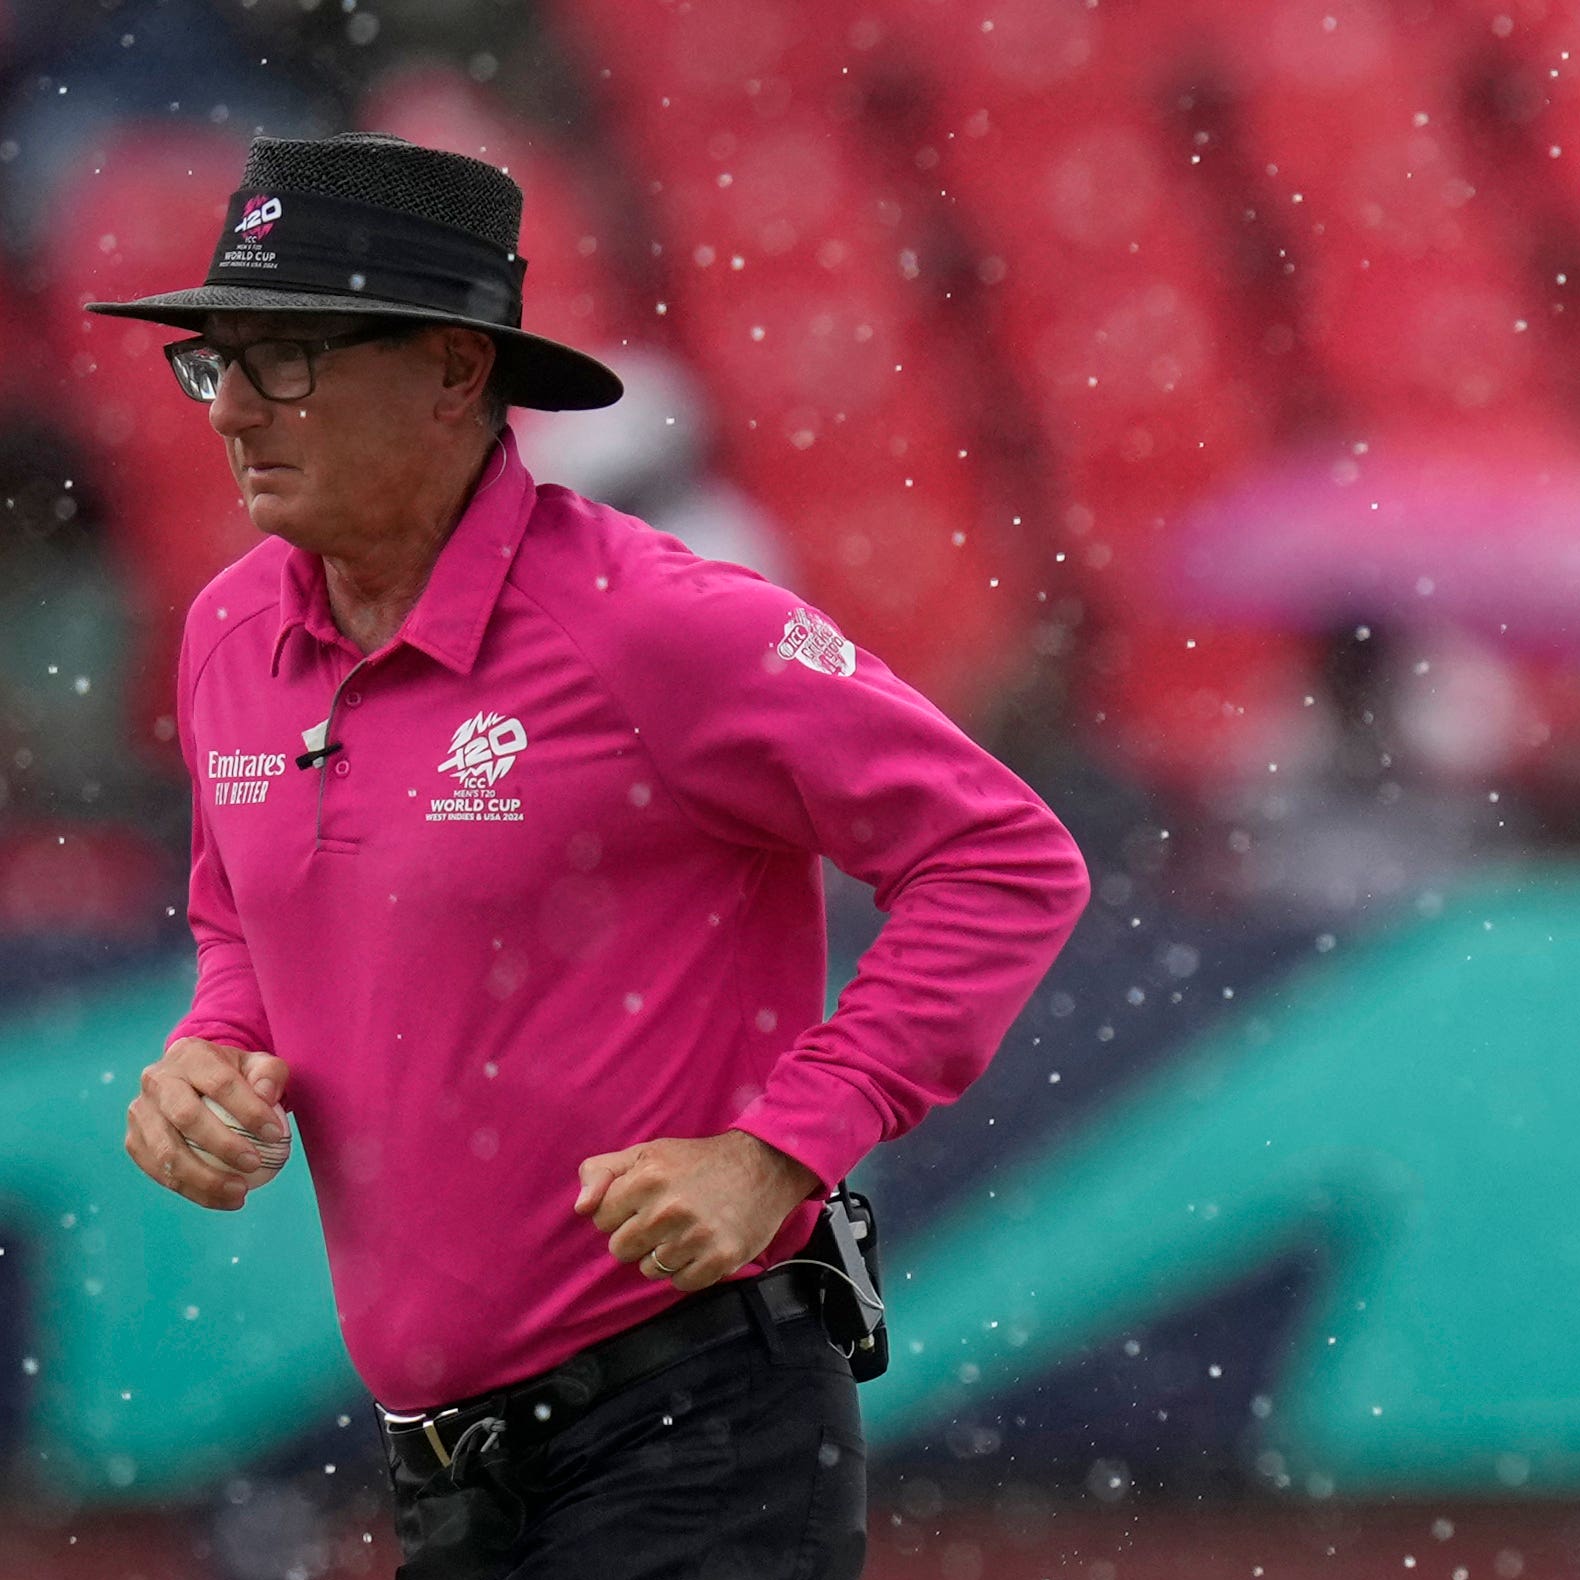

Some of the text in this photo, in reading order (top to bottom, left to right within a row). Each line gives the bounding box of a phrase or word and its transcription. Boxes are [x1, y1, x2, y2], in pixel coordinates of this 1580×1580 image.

[224, 251, 276, 261] WORLD CUP
[788, 627, 806, 649] ICC
[208, 749, 286, 778] Emirates
[464, 777, 486, 789] ICC
[215, 781, 269, 805] FLY BETTER
[453, 789, 496, 798] MEN'S T20
[430, 799, 521, 812] WORLD CUP
[425, 813, 446, 821] WEST
[447, 813, 475, 821] INDIES
[483, 813, 501, 821] USA
[502, 813, 524, 821] 2024
